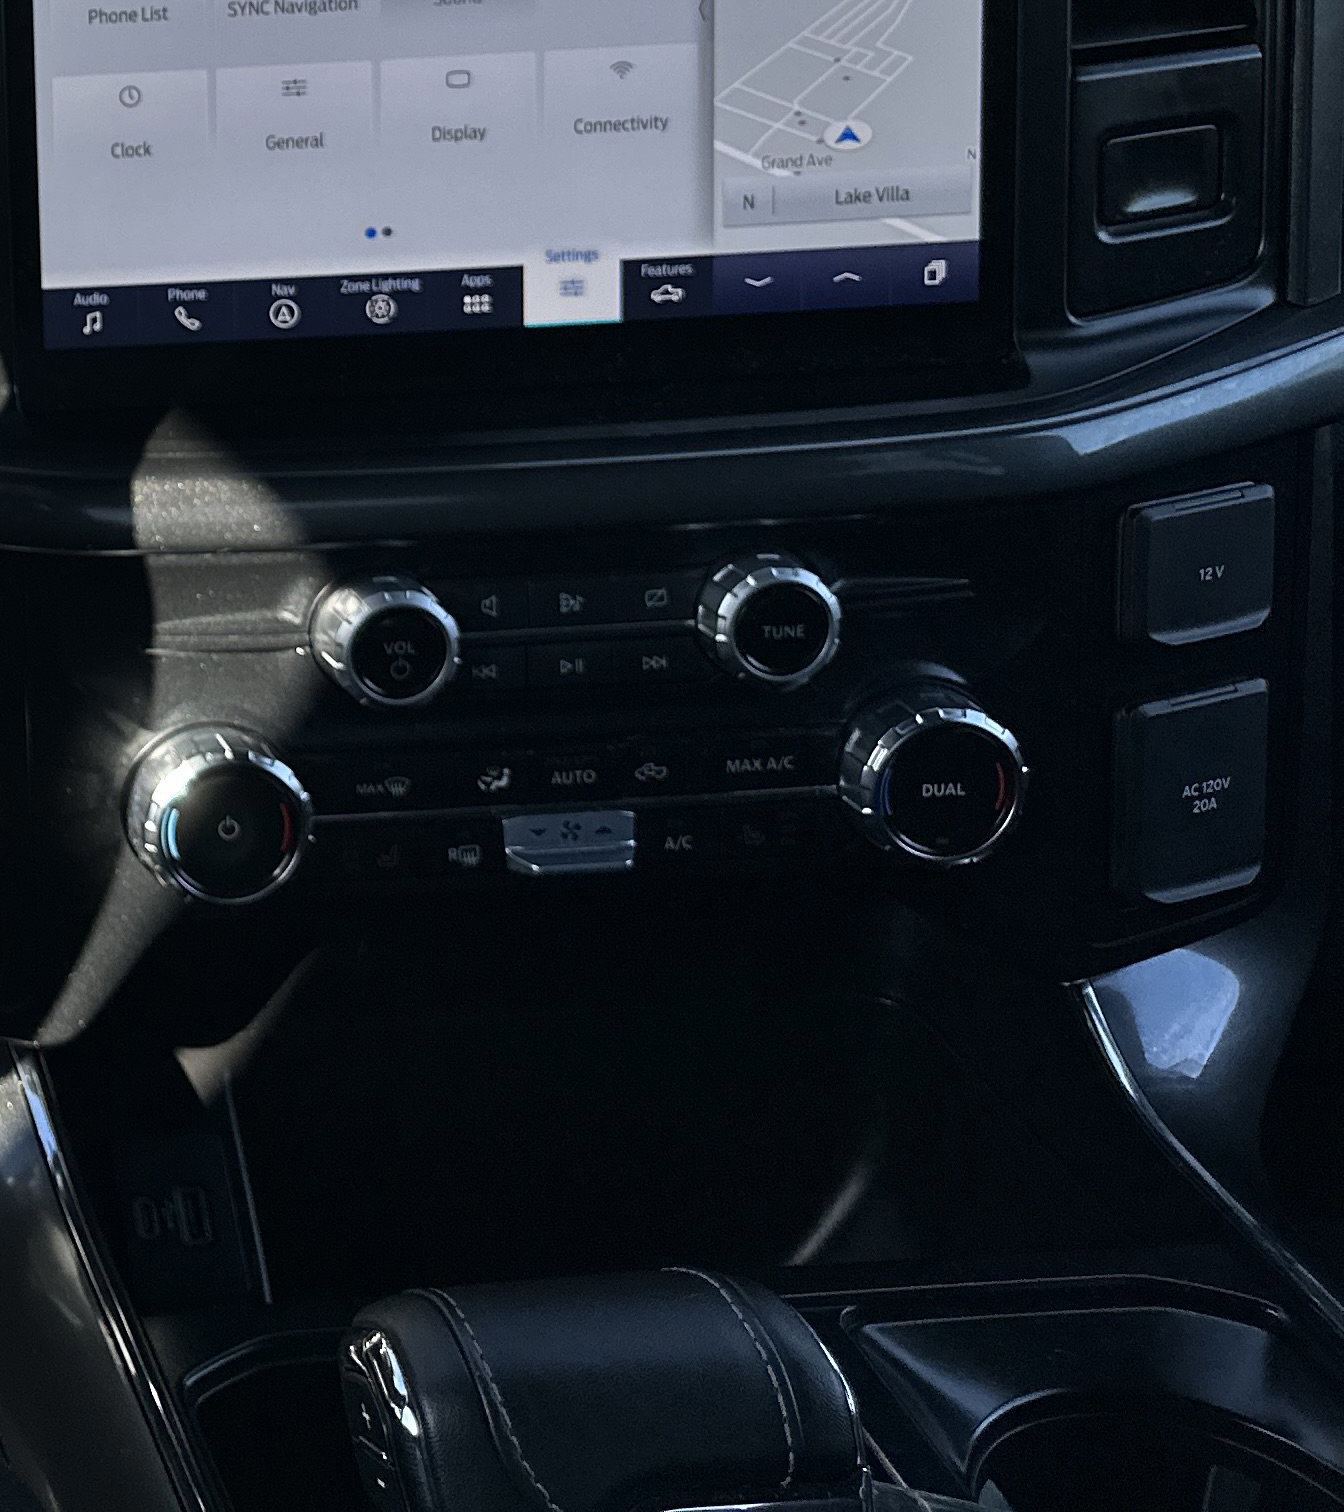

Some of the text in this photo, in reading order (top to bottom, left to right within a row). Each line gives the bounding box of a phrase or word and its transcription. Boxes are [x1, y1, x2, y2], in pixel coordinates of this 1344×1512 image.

[88, 3, 169, 25] Phone List
[431, 123, 487, 146] Display
[572, 114, 669, 139] Connectivity
[110, 140, 153, 160] Clock
[265, 131, 325, 152] General
[760, 152, 834, 171] Grand Ave
[742, 193, 756, 212] N
[834, 185, 911, 206] Lake Villa
[544, 247, 600, 266] Settings
[640, 261, 694, 278] Features
[270, 283, 296, 297] Nav
[339, 275, 421, 294] Zone Lighting
[460, 273, 492, 290] Apps
[73, 291, 109, 306] Audio
[166, 286, 208, 302] Phone
[1198, 564, 1225, 581] 12 V
[762, 623, 806, 641] TUNE
[382, 640, 416, 657] VOL
[725, 754, 796, 775] MAX A/C
[551, 768, 598, 786] AUTO
[921, 782, 967, 799] DUAL
[1181, 776, 1231, 800] AC 120V
[1192, 797, 1218, 814] 20A
[664, 833, 694, 852] A/C
